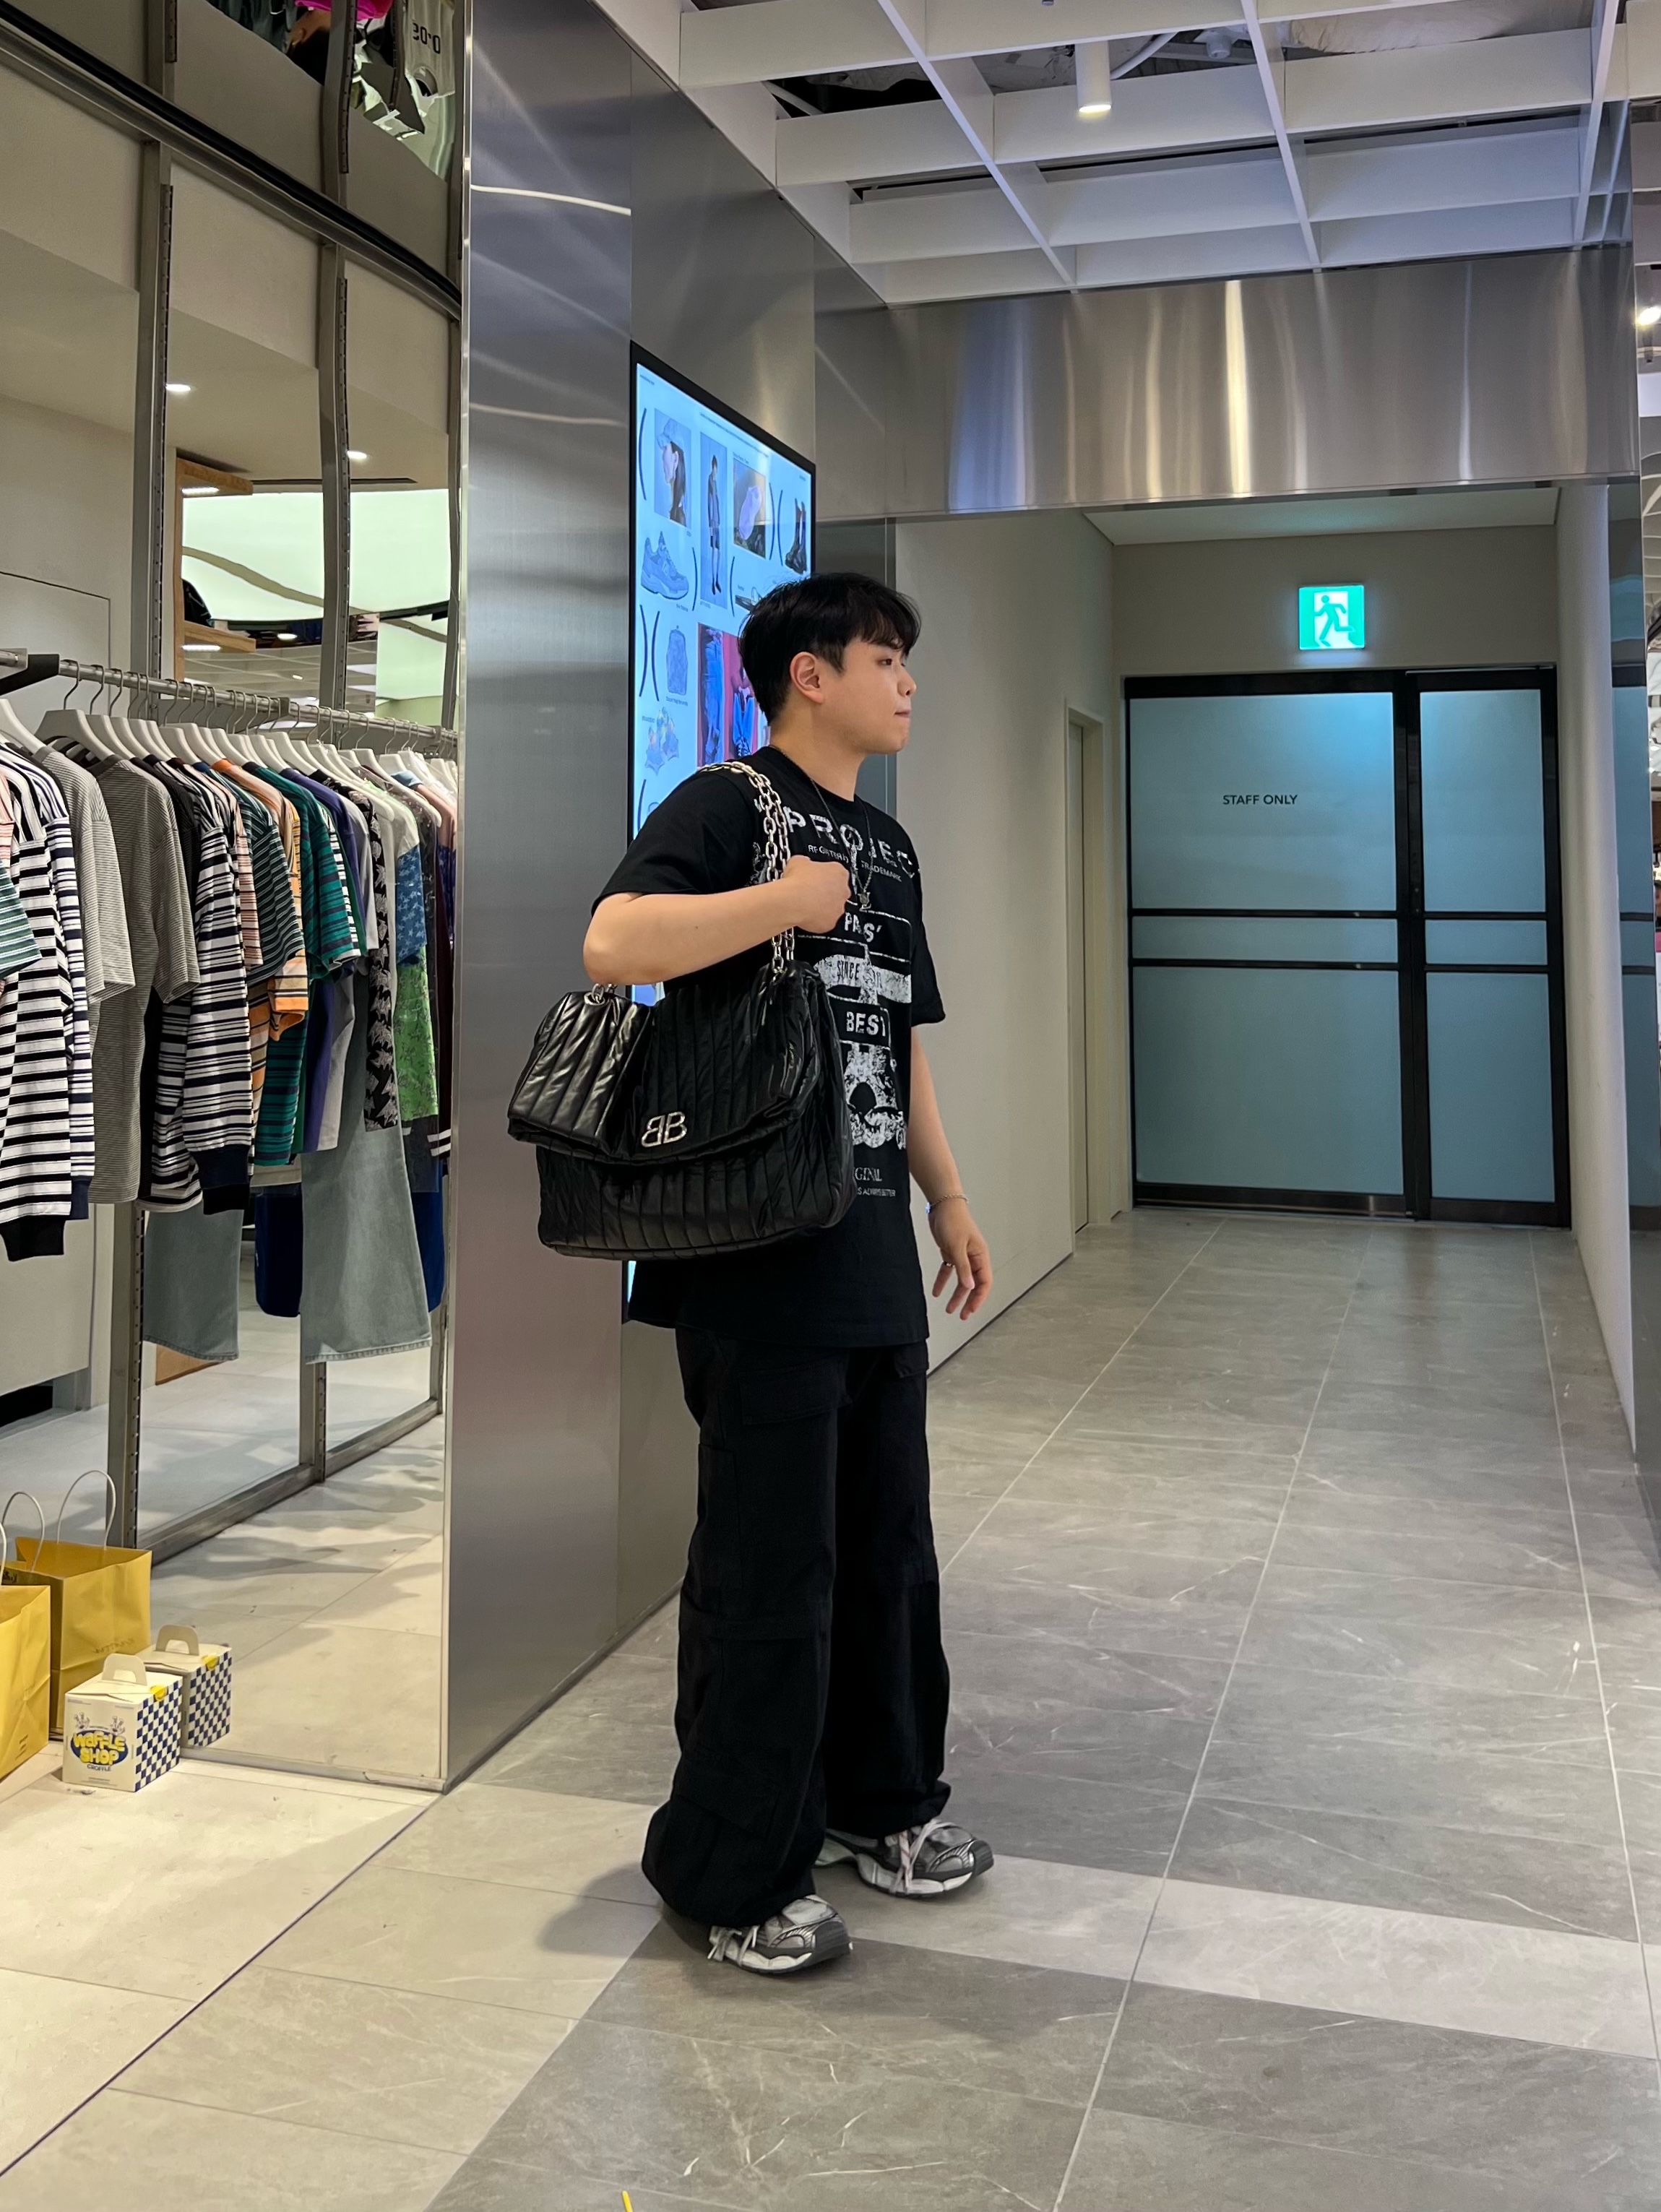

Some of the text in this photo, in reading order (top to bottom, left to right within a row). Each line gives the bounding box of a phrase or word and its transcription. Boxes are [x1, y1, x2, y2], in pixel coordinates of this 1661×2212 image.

[1222, 794, 1298, 805] STAFF ONLY
[782, 805, 915, 879] PROJEC
[837, 959, 860, 980] SINCE
[79, 1746, 120, 1766] SHOP
